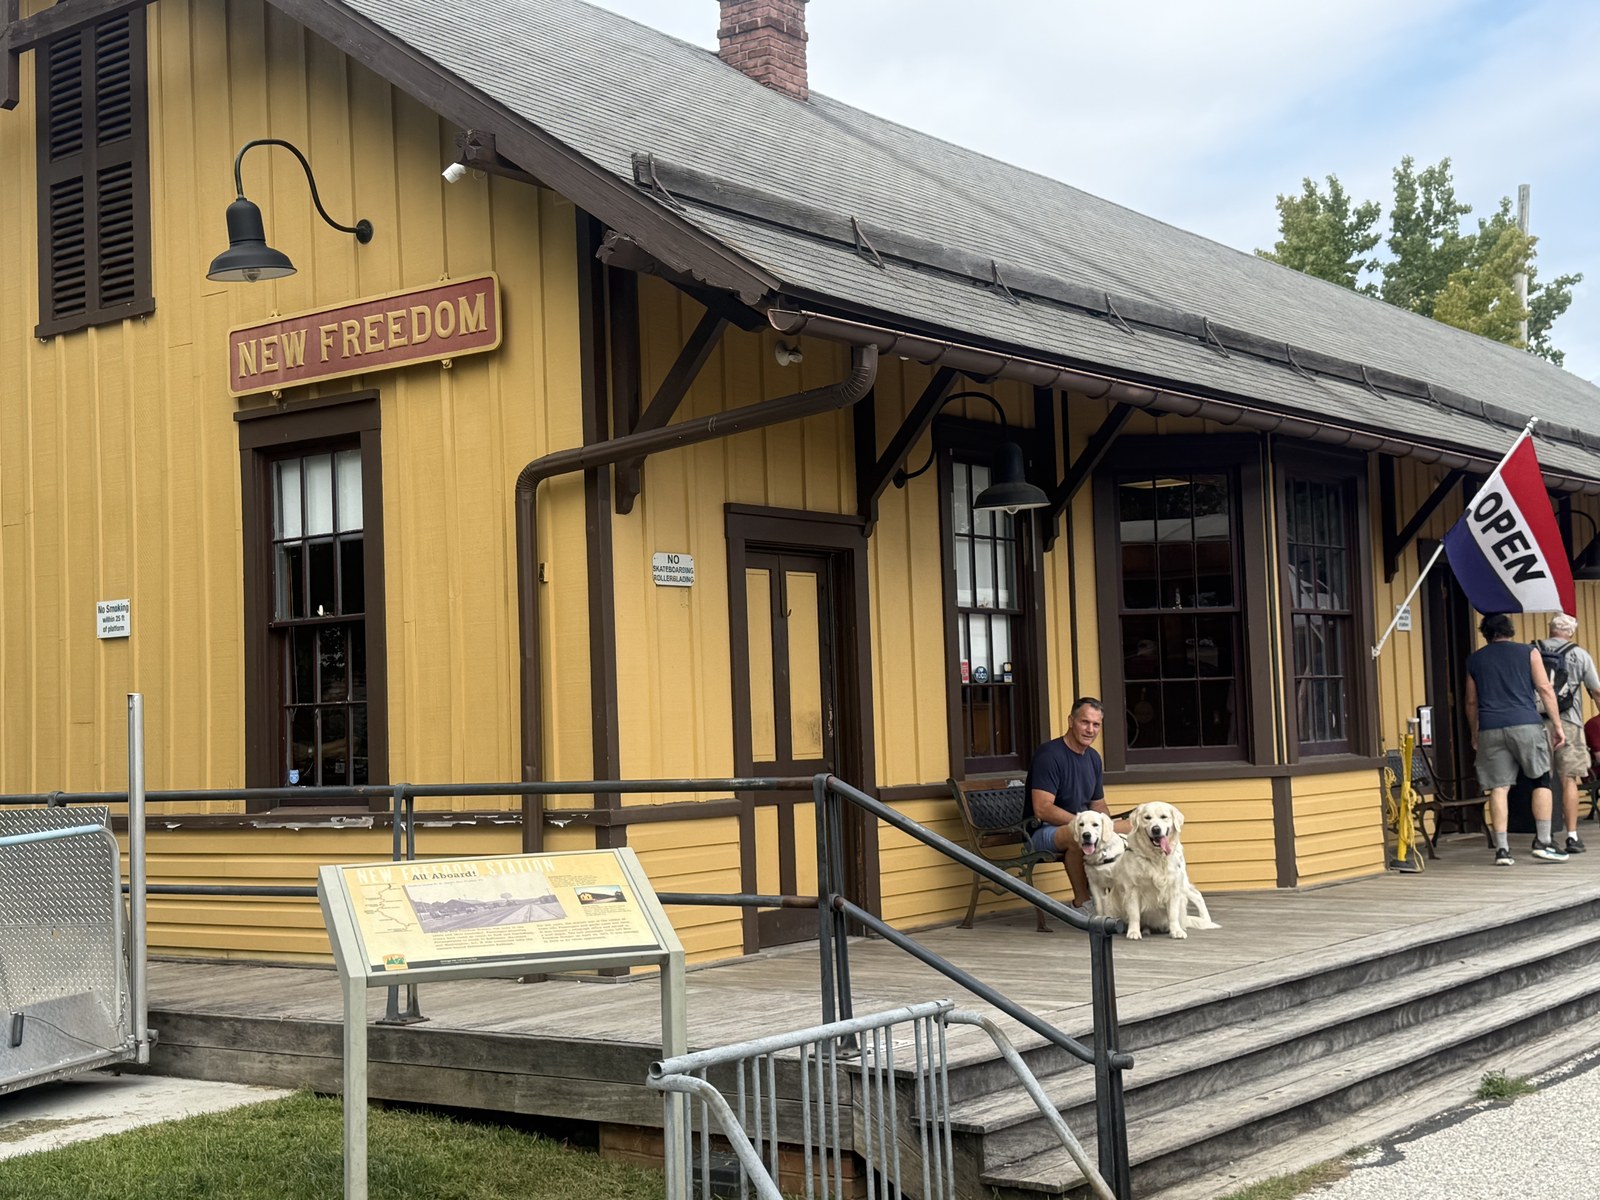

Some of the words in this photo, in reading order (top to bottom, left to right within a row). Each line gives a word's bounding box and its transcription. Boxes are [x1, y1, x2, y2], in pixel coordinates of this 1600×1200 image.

[237, 329, 308, 378] NEW
[319, 292, 488, 363] FREEDOM
[1473, 491, 1547, 585] OPEN
[667, 554, 680, 564] NO
[653, 565, 694, 574] SKATEBOARDING
[653, 574, 694, 584] ROLLERBLADING
[98, 606, 105, 614] No
[106, 603, 129, 613] Smoking
[356, 868, 392, 884] NEW
[485, 858, 556, 876] STATION
[412, 873, 428, 881] All
[432, 870, 477, 880] Aboard!
